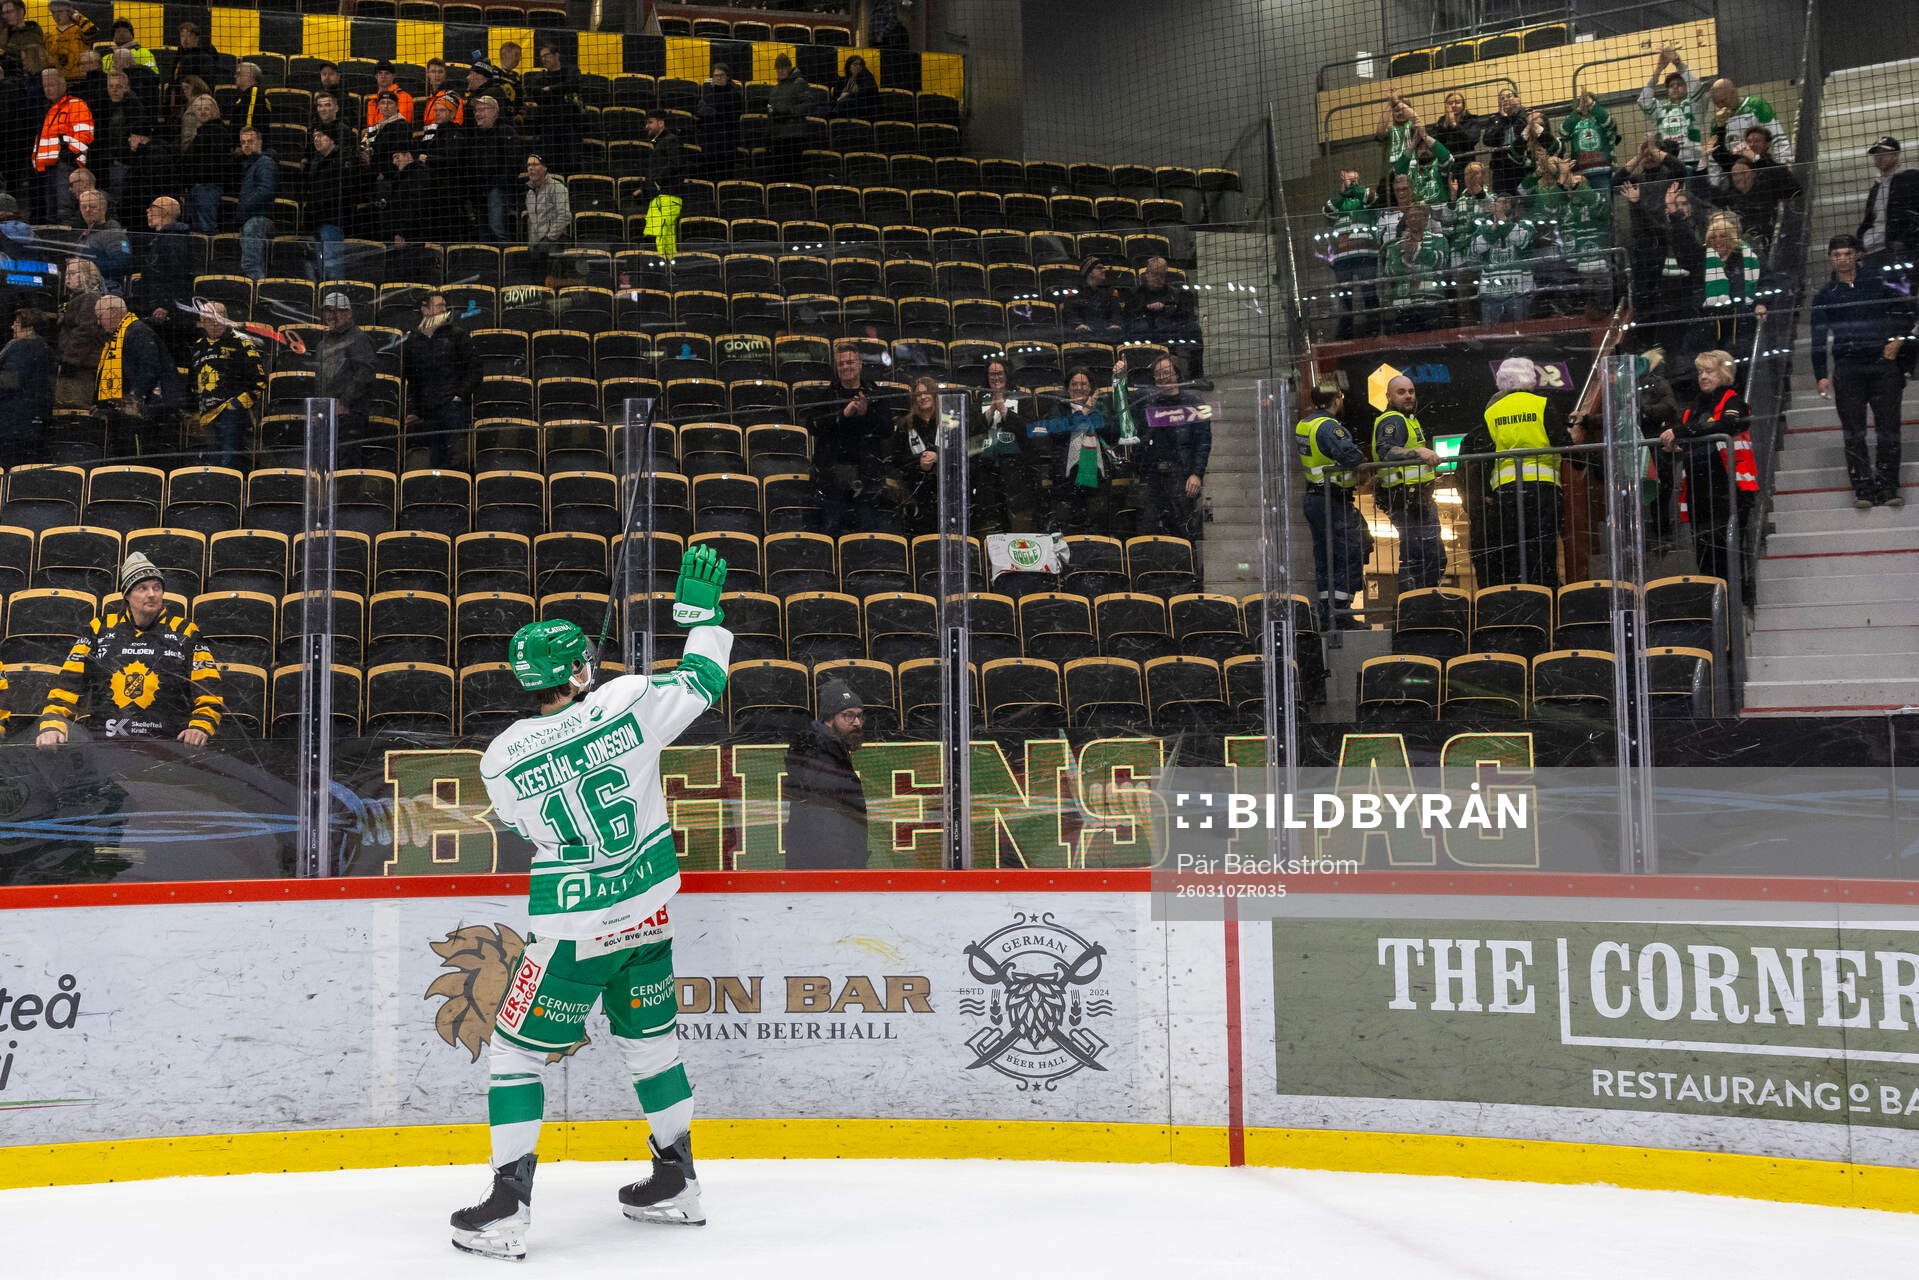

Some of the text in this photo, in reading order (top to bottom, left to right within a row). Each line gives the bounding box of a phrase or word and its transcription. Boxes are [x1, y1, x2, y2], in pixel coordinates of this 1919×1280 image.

[539, 763, 638, 864] 16
[1001, 935, 1068, 955] GERMAN
[505, 962, 534, 1021] ER-HO
[958, 987, 1110, 997] ESTD 2024
[1377, 937, 1537, 1014] THE
[1589, 940, 1919, 1031] CORNER
[519, 983, 538, 1015] BYGG
[538, 994, 592, 1013] CERNITO
[671, 975, 936, 1014] ON BAR
[675, 1022, 898, 1040] RMAN BEER HALL
[1005, 1054, 1068, 1069] BEER HALL
[1592, 1068, 1841, 1113] RESTAURANG
